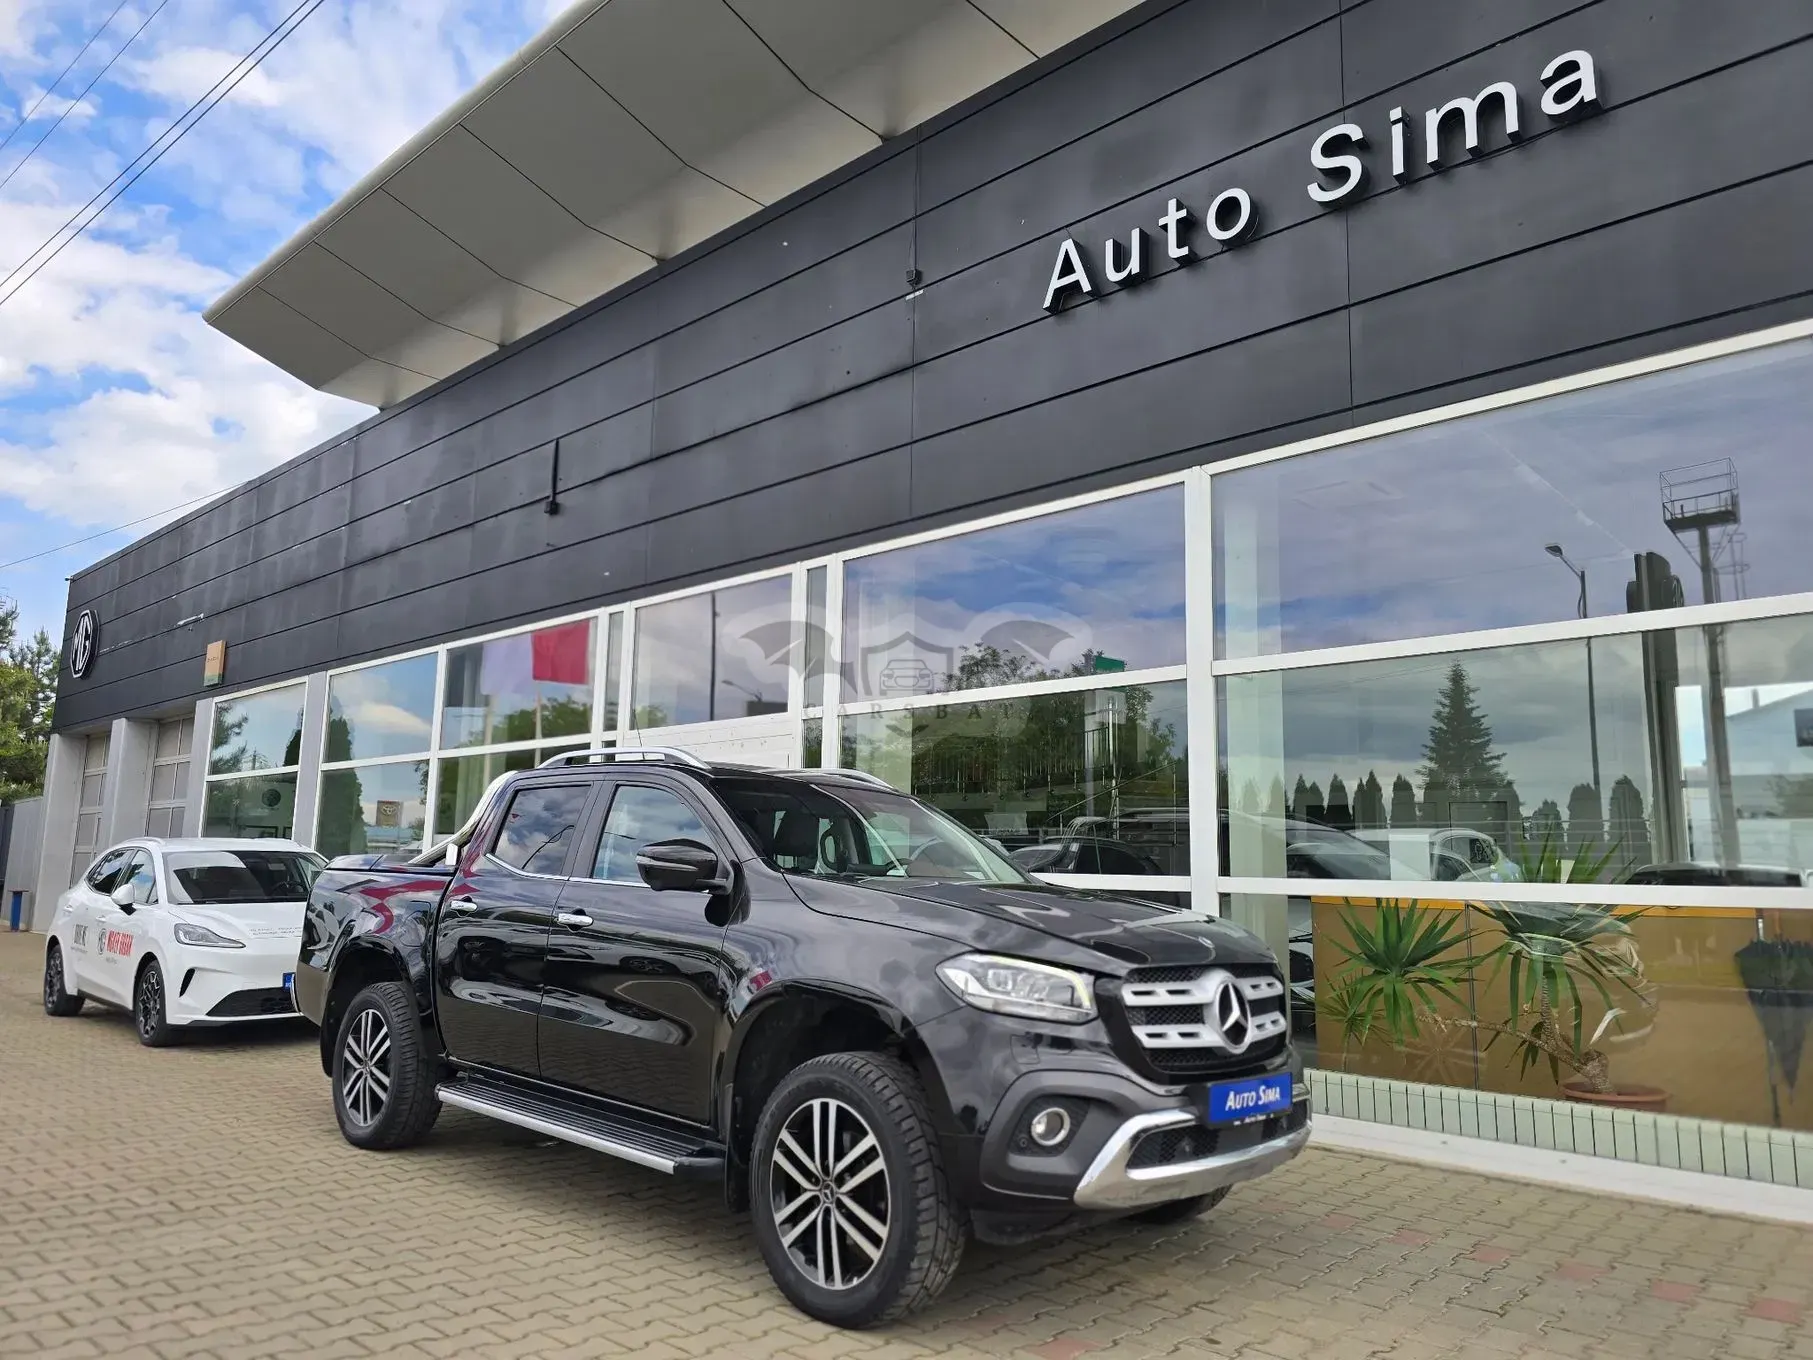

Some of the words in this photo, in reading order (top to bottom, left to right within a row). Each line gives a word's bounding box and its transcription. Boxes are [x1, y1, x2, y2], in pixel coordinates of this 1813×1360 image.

[1043, 187, 1253, 312] Auto
[1307, 49, 1599, 203] Sima
[72, 613, 92, 673] MG
